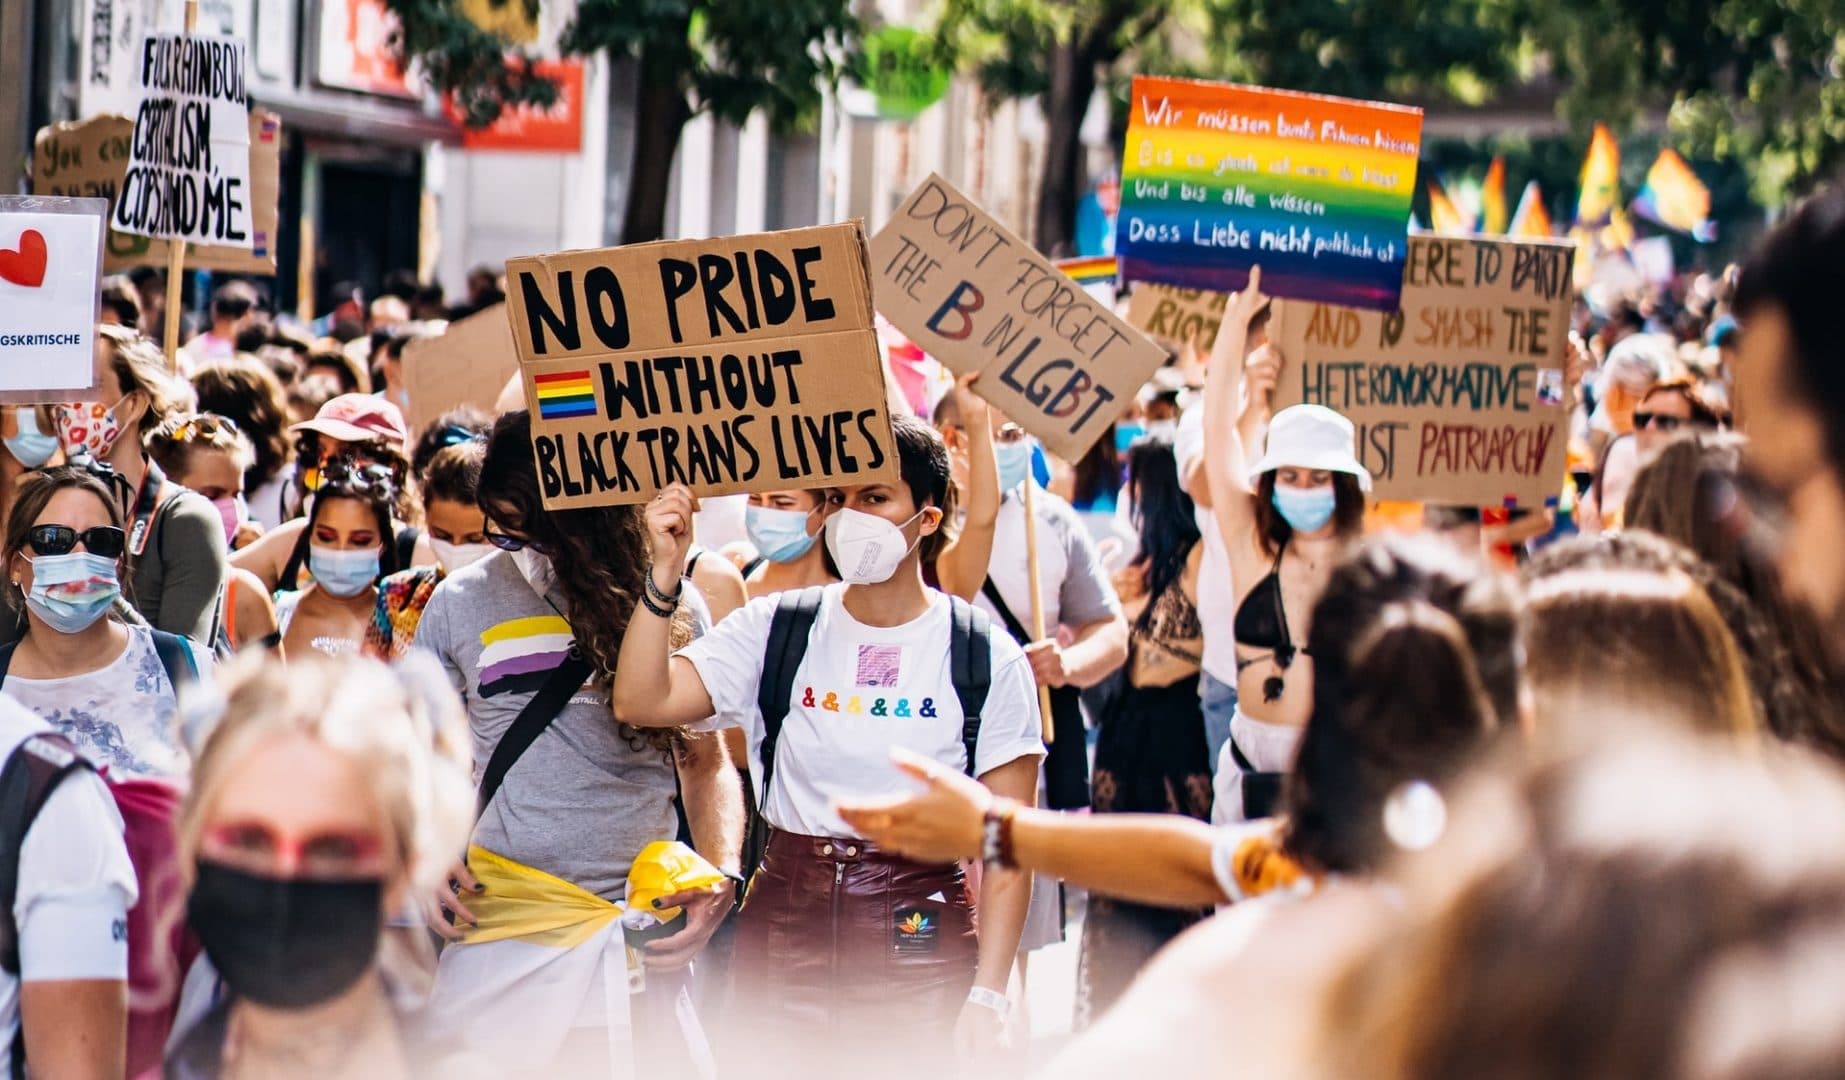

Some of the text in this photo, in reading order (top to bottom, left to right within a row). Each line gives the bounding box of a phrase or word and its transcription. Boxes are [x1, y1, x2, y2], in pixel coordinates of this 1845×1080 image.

[1142, 95, 1184, 126] Wir
[1196, 108, 1271, 136] müssen
[201, 174, 246, 241] ME
[1134, 180, 1326, 217] Und bis alle wissen
[1128, 216, 1181, 243] Dass
[1193, 219, 1251, 249] Liebe
[1259, 223, 1311, 254] nicht
[1404, 239, 1465, 288] ERE
[1470, 240, 1503, 288] TO
[519, 245, 837, 355] NO PRIDE
[906, 181, 1132, 362] DON'T FORGET
[883, 234, 1115, 435] THE B IN LGBT
[1303, 302, 1362, 349] AND
[1413, 304, 1495, 349] SMASH
[1502, 304, 1550, 356] THE
[598, 349, 803, 421] WITHOUT
[1301, 360, 1537, 412] HETERONORMATIVE
[534, 408, 885, 499] BLACK TRANS LIVES
[1358, 421, 1410, 483] IST
